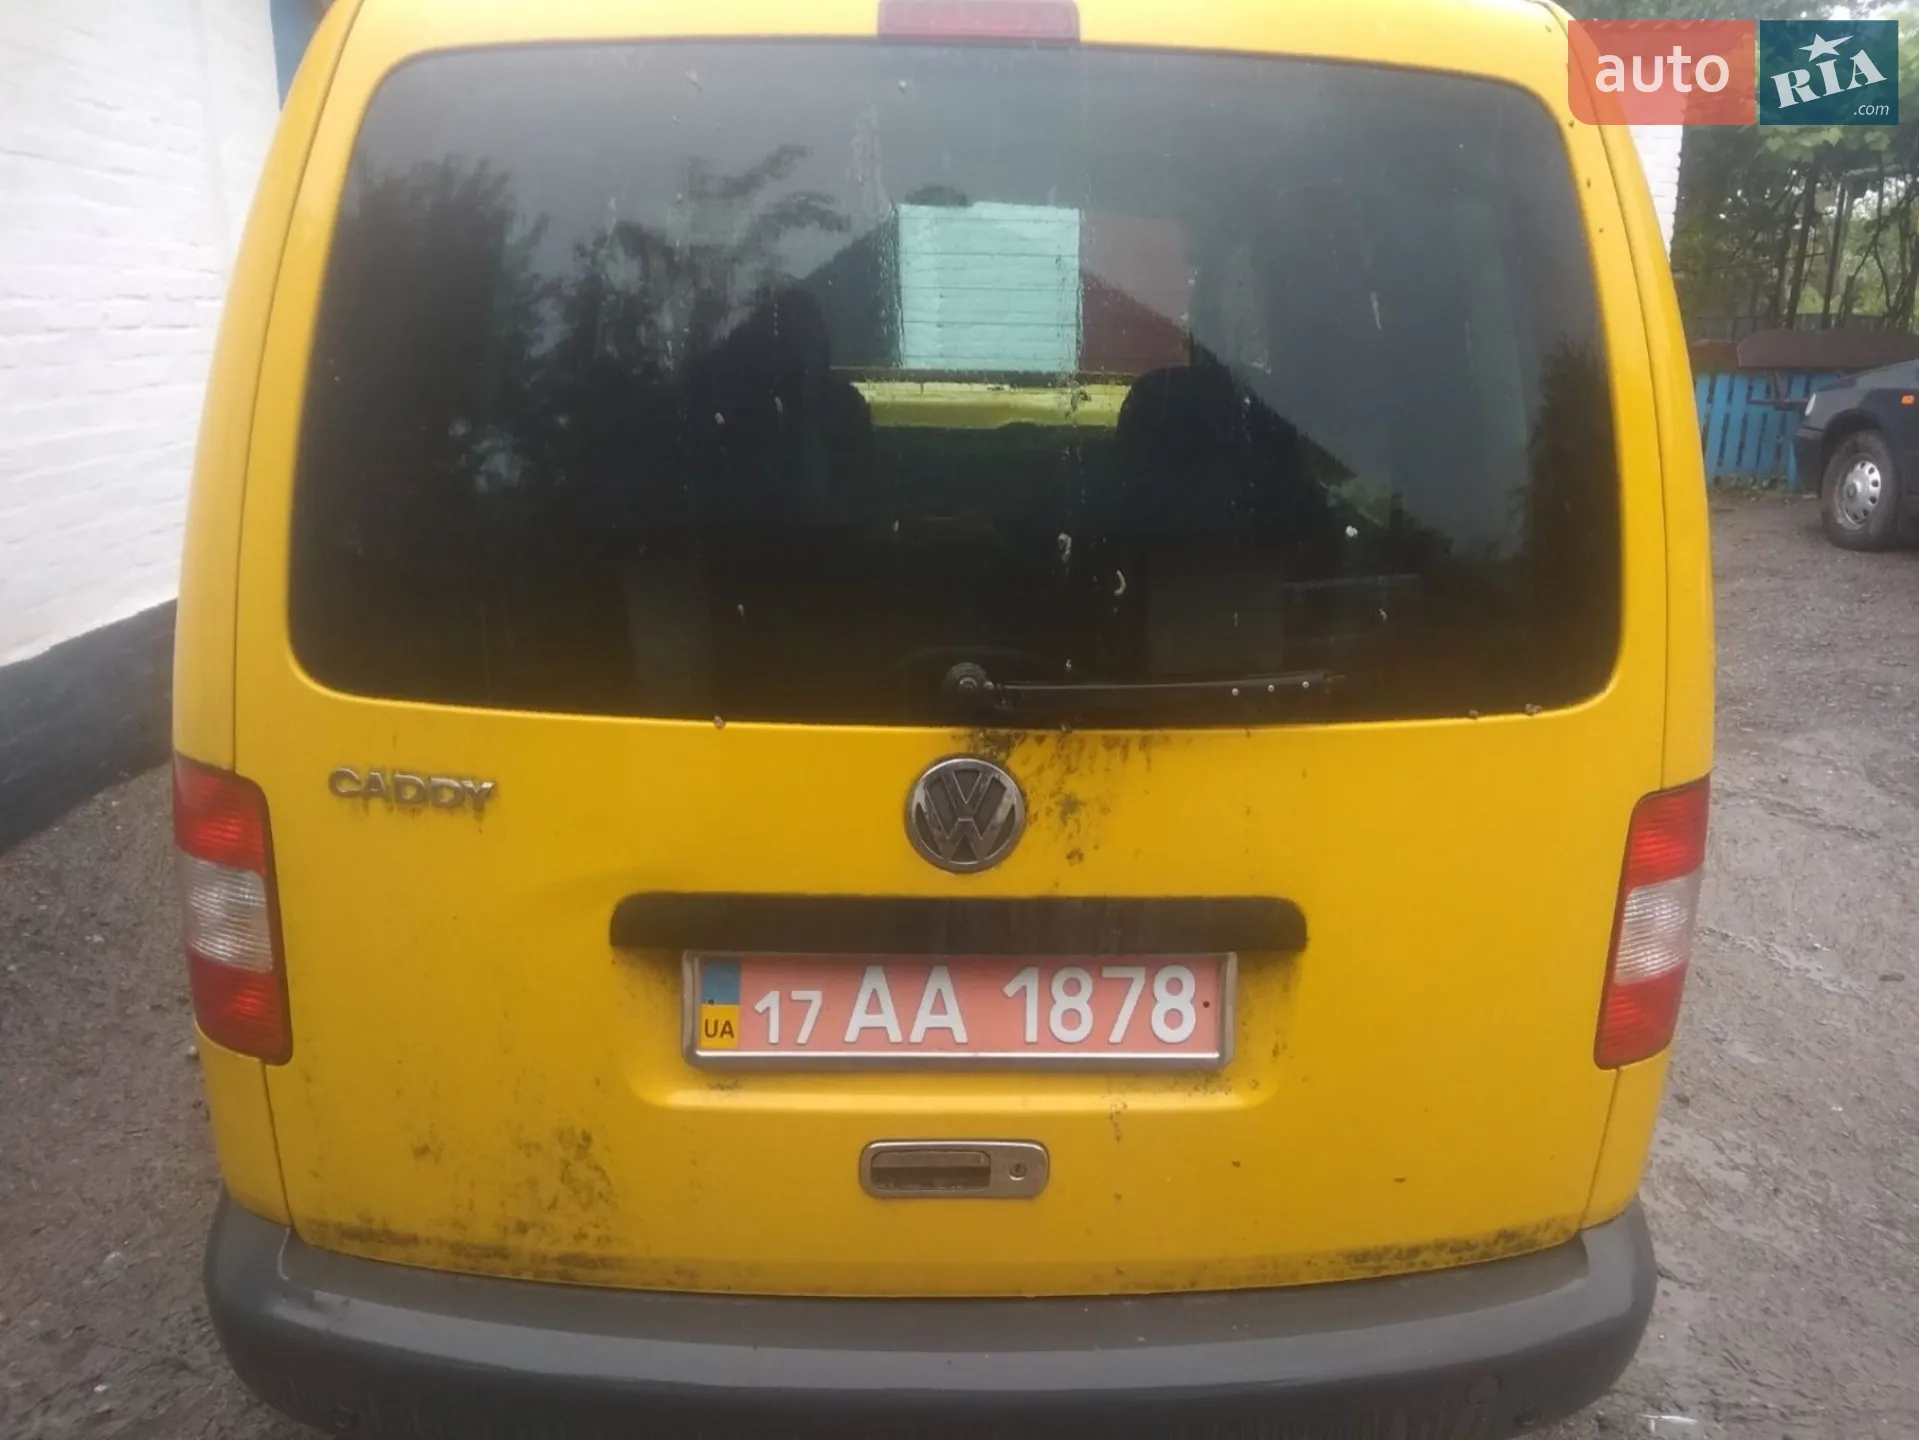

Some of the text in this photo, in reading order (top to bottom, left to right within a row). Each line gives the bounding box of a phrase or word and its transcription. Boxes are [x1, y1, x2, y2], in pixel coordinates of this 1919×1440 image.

[328, 767, 497, 812] CADDY
[754, 964, 1197, 1045] 17 AA 1878
[703, 1018, 736, 1040] UA
